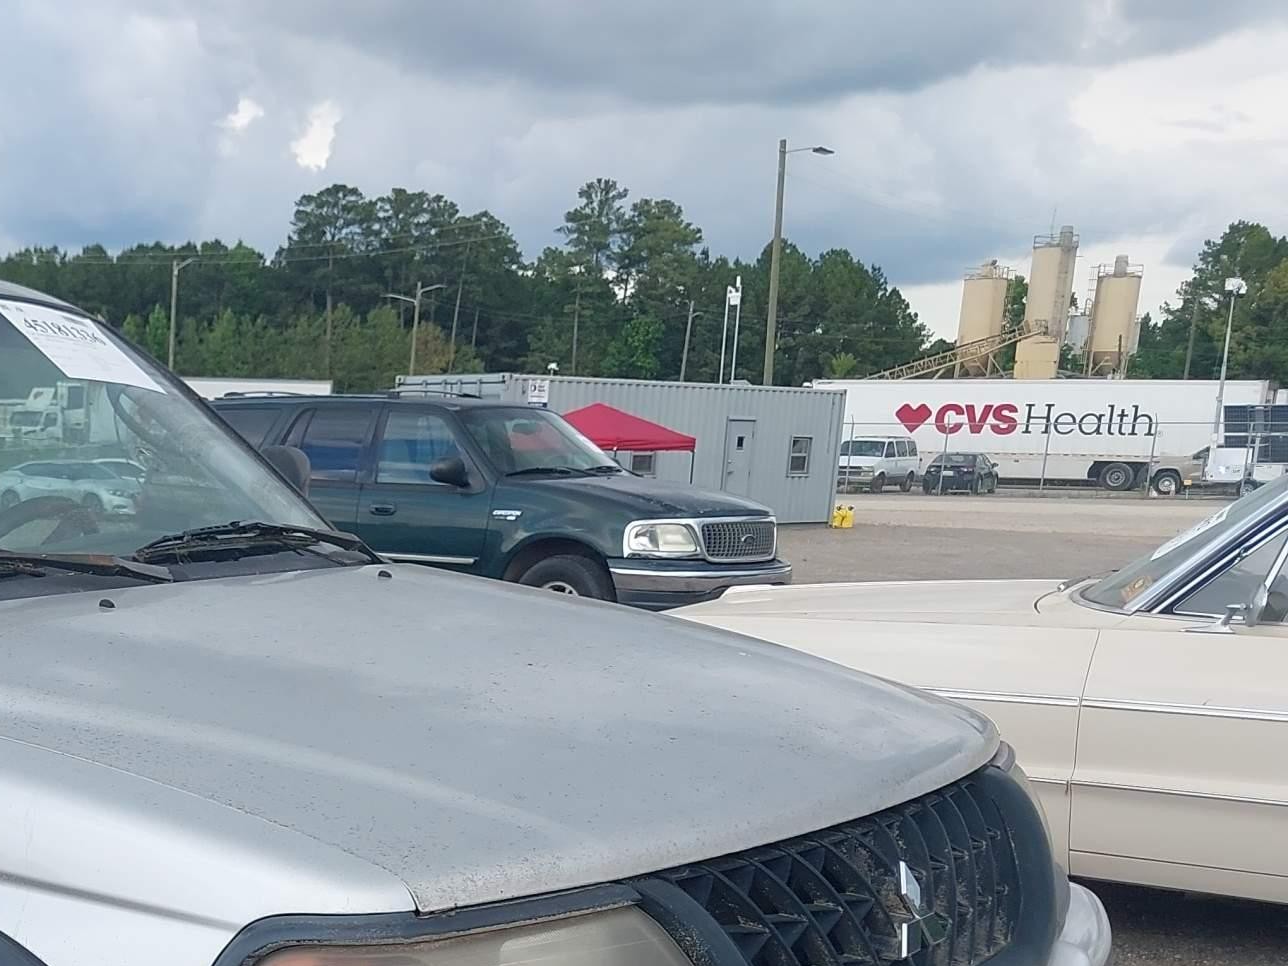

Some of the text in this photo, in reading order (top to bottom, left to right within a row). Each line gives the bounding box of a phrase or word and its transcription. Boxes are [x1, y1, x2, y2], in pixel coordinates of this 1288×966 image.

[23, 317, 107, 346] 45181336
[934, 403, 1155, 436] CVS Health
